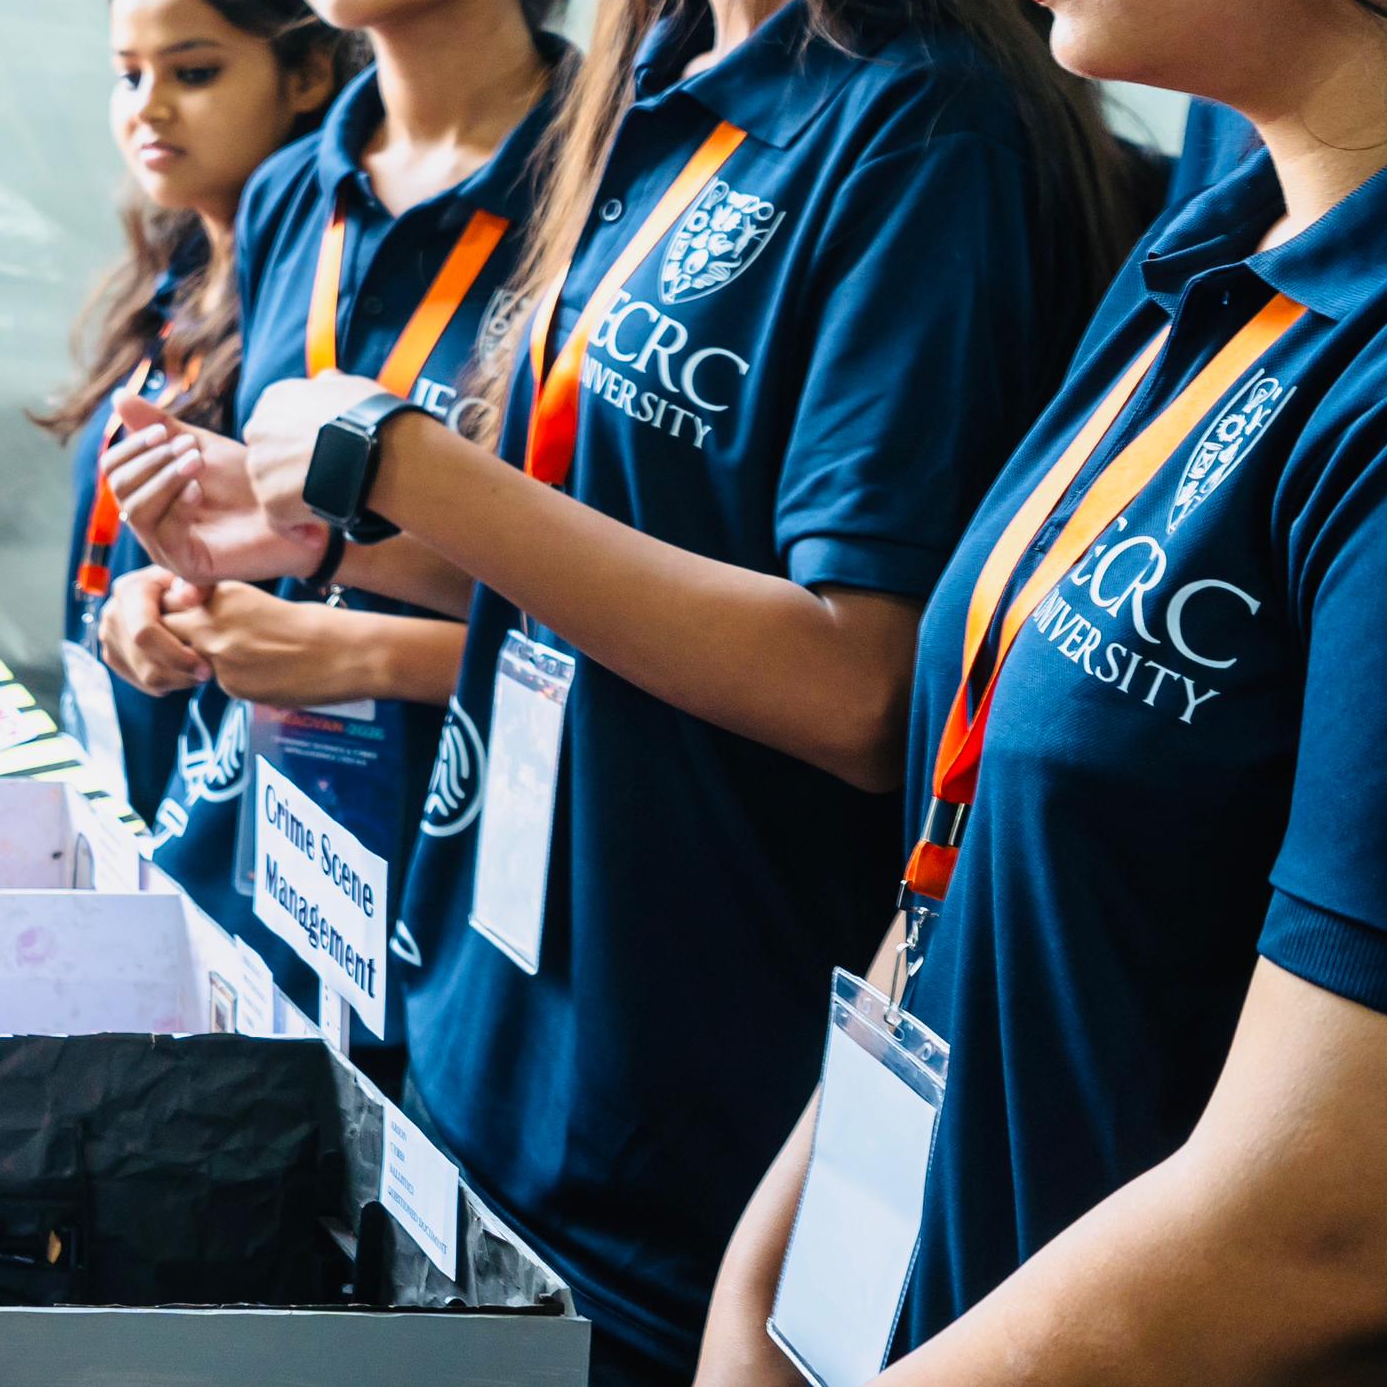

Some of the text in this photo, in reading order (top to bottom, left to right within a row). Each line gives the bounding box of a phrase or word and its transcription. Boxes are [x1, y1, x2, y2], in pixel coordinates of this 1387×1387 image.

[582, 353, 712, 449] NIVERSITY
[588, 289, 750, 412] ECRC
[1070, 516, 1261, 669] ECRC
[265, 784, 374, 918] Crime Scene
[266, 852, 377, 999] Management
